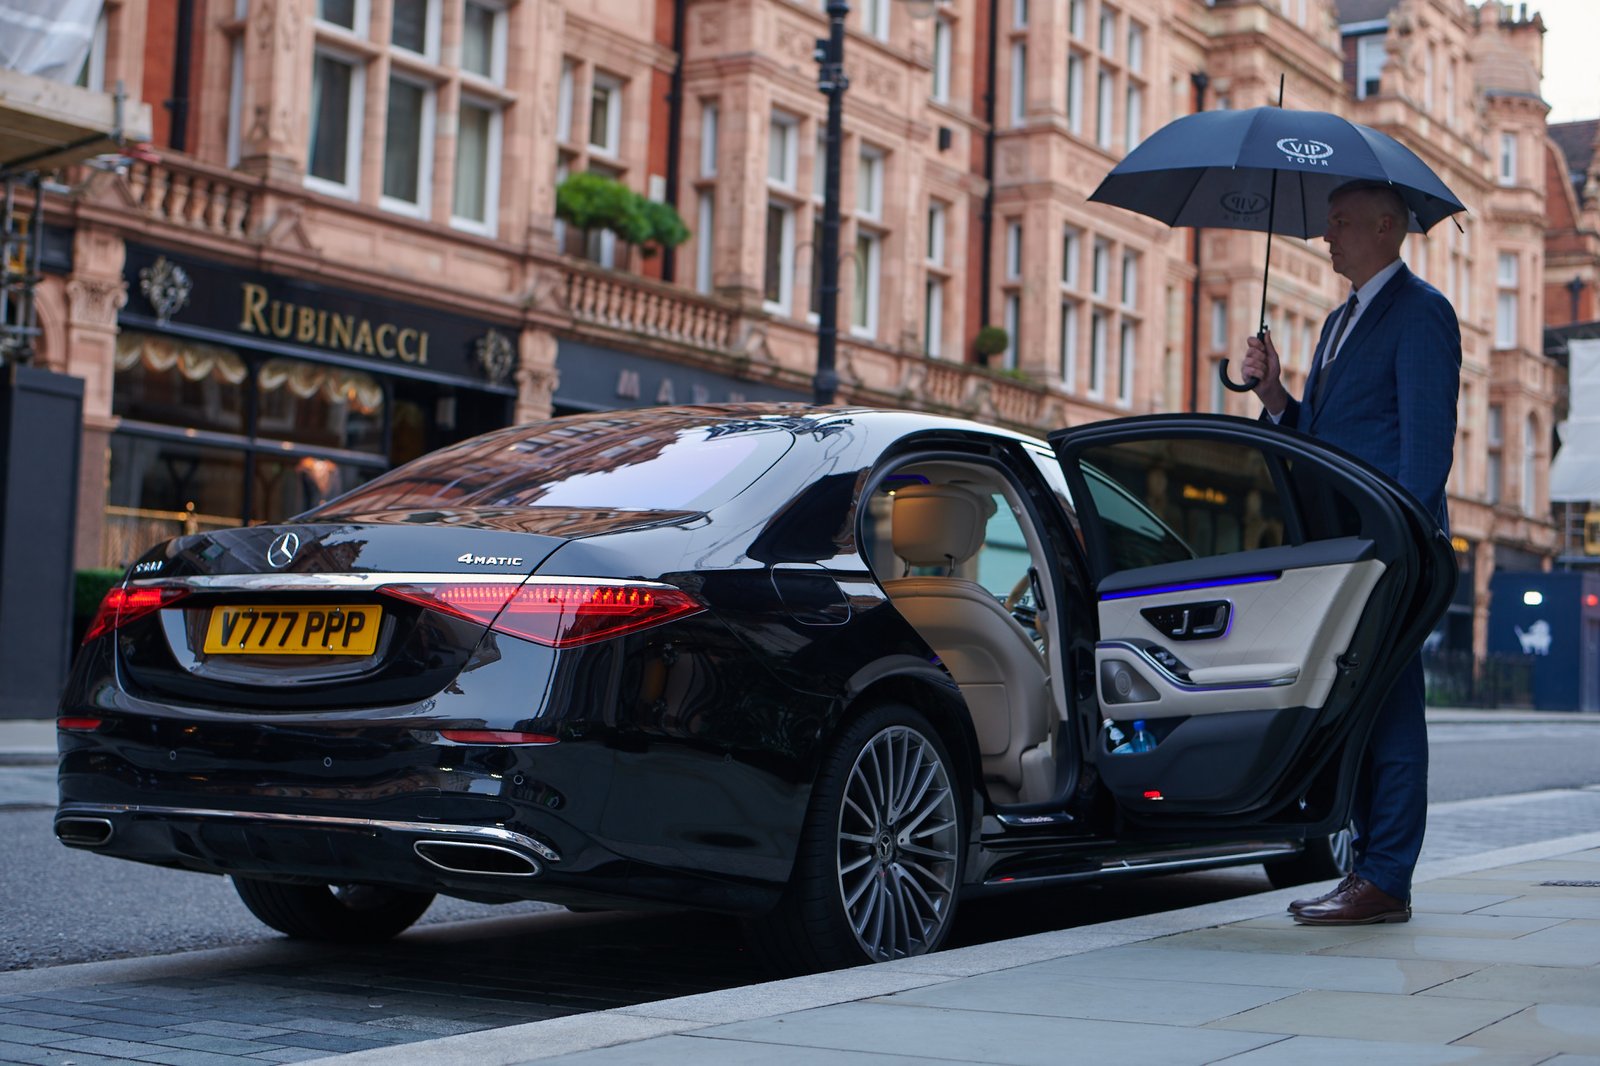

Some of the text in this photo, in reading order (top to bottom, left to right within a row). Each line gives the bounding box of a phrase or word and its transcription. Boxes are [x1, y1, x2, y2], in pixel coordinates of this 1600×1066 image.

[1289, 142, 1321, 154] VIP
[1286, 156, 1328, 166] TOUR
[239, 283, 429, 364] RUBINACCI
[457, 553, 523, 566] 4MATIC
[221, 611, 366, 648] V777 PPP
